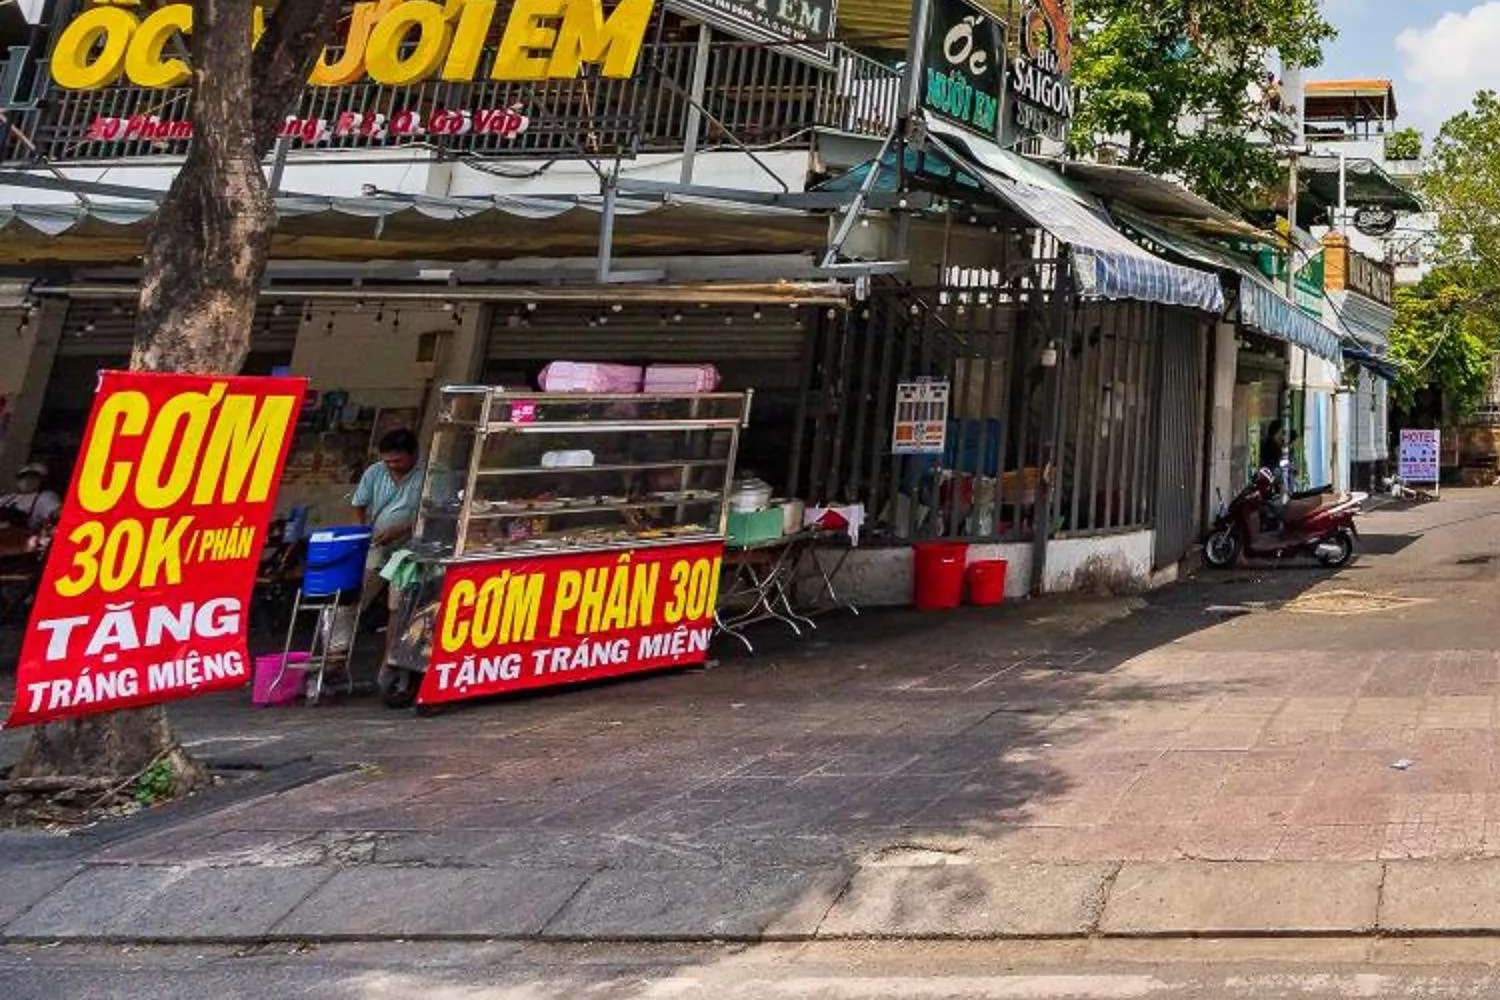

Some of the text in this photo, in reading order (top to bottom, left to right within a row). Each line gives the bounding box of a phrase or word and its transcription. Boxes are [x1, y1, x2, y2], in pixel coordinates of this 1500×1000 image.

[77, 381, 297, 514] CƠM
[1402, 431, 1436, 442] HOTEL
[55, 515, 195, 597] 30K
[37, 597, 242, 664] TẶNG
[441, 568, 546, 652] CƠM
[28, 650, 246, 713] TRÁNG MIỆNG
[436, 652, 521, 694] TẶNG
[532, 636, 629, 676] TRÁNG
